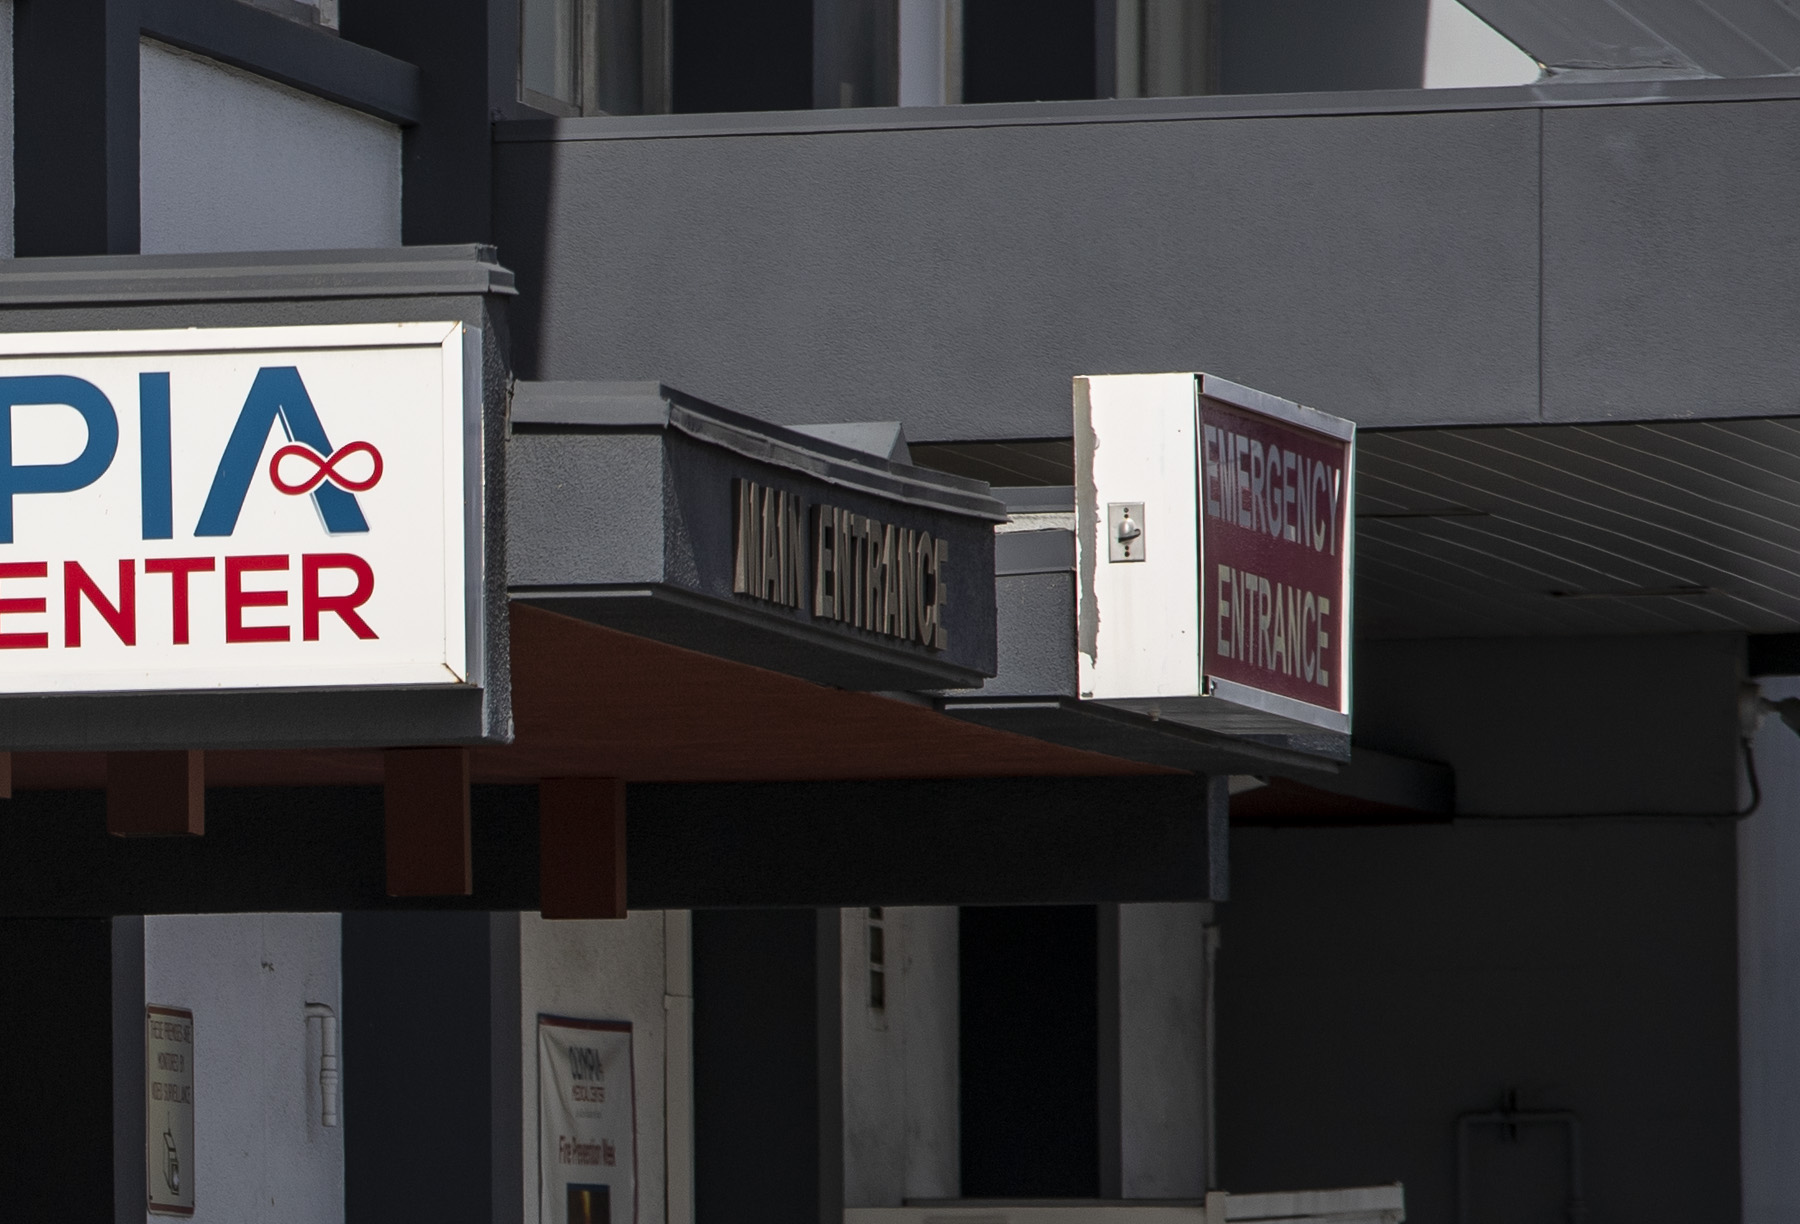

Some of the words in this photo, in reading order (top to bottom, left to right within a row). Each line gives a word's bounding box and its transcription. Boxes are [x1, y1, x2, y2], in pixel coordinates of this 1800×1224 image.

[1202, 422, 1342, 557] EMERGENCY
[734, 478, 802, 608] MAIN
[811, 503, 949, 652] ENTRANCE
[1217, 564, 1330, 688] ENTRANCE
